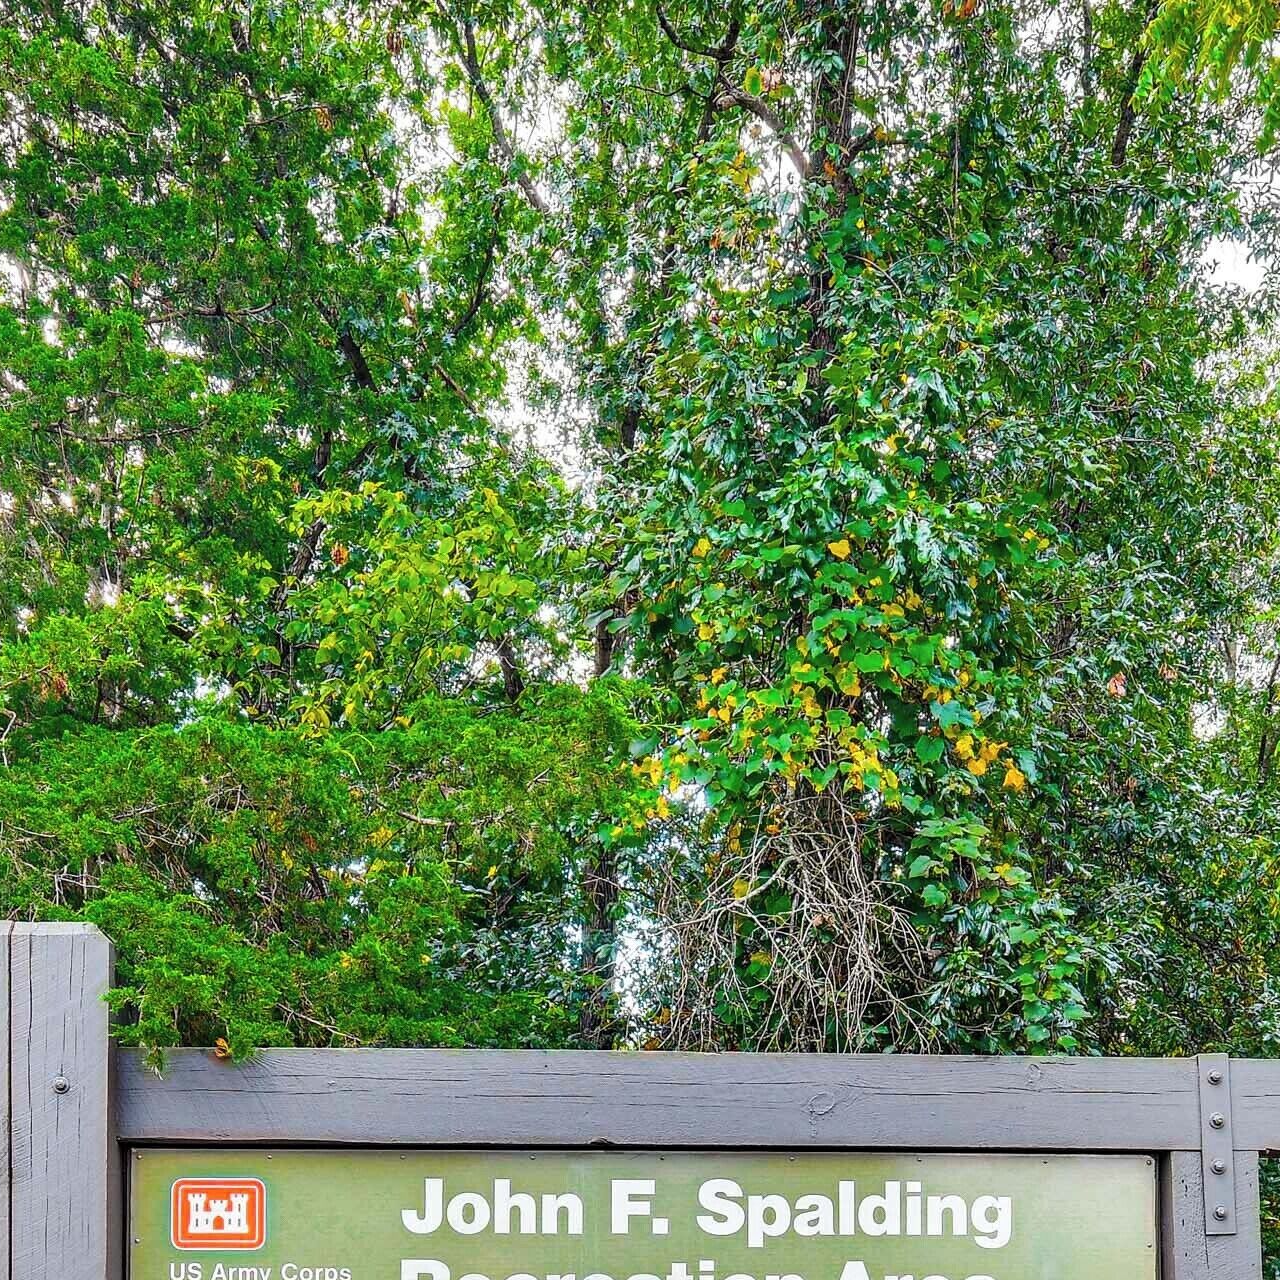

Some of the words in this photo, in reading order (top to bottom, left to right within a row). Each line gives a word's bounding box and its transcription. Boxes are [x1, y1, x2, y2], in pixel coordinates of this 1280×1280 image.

[400, 1177, 585, 1236] John
[610, 1178, 670, 1236] F.
[696, 1177, 1013, 1249] Spalding
